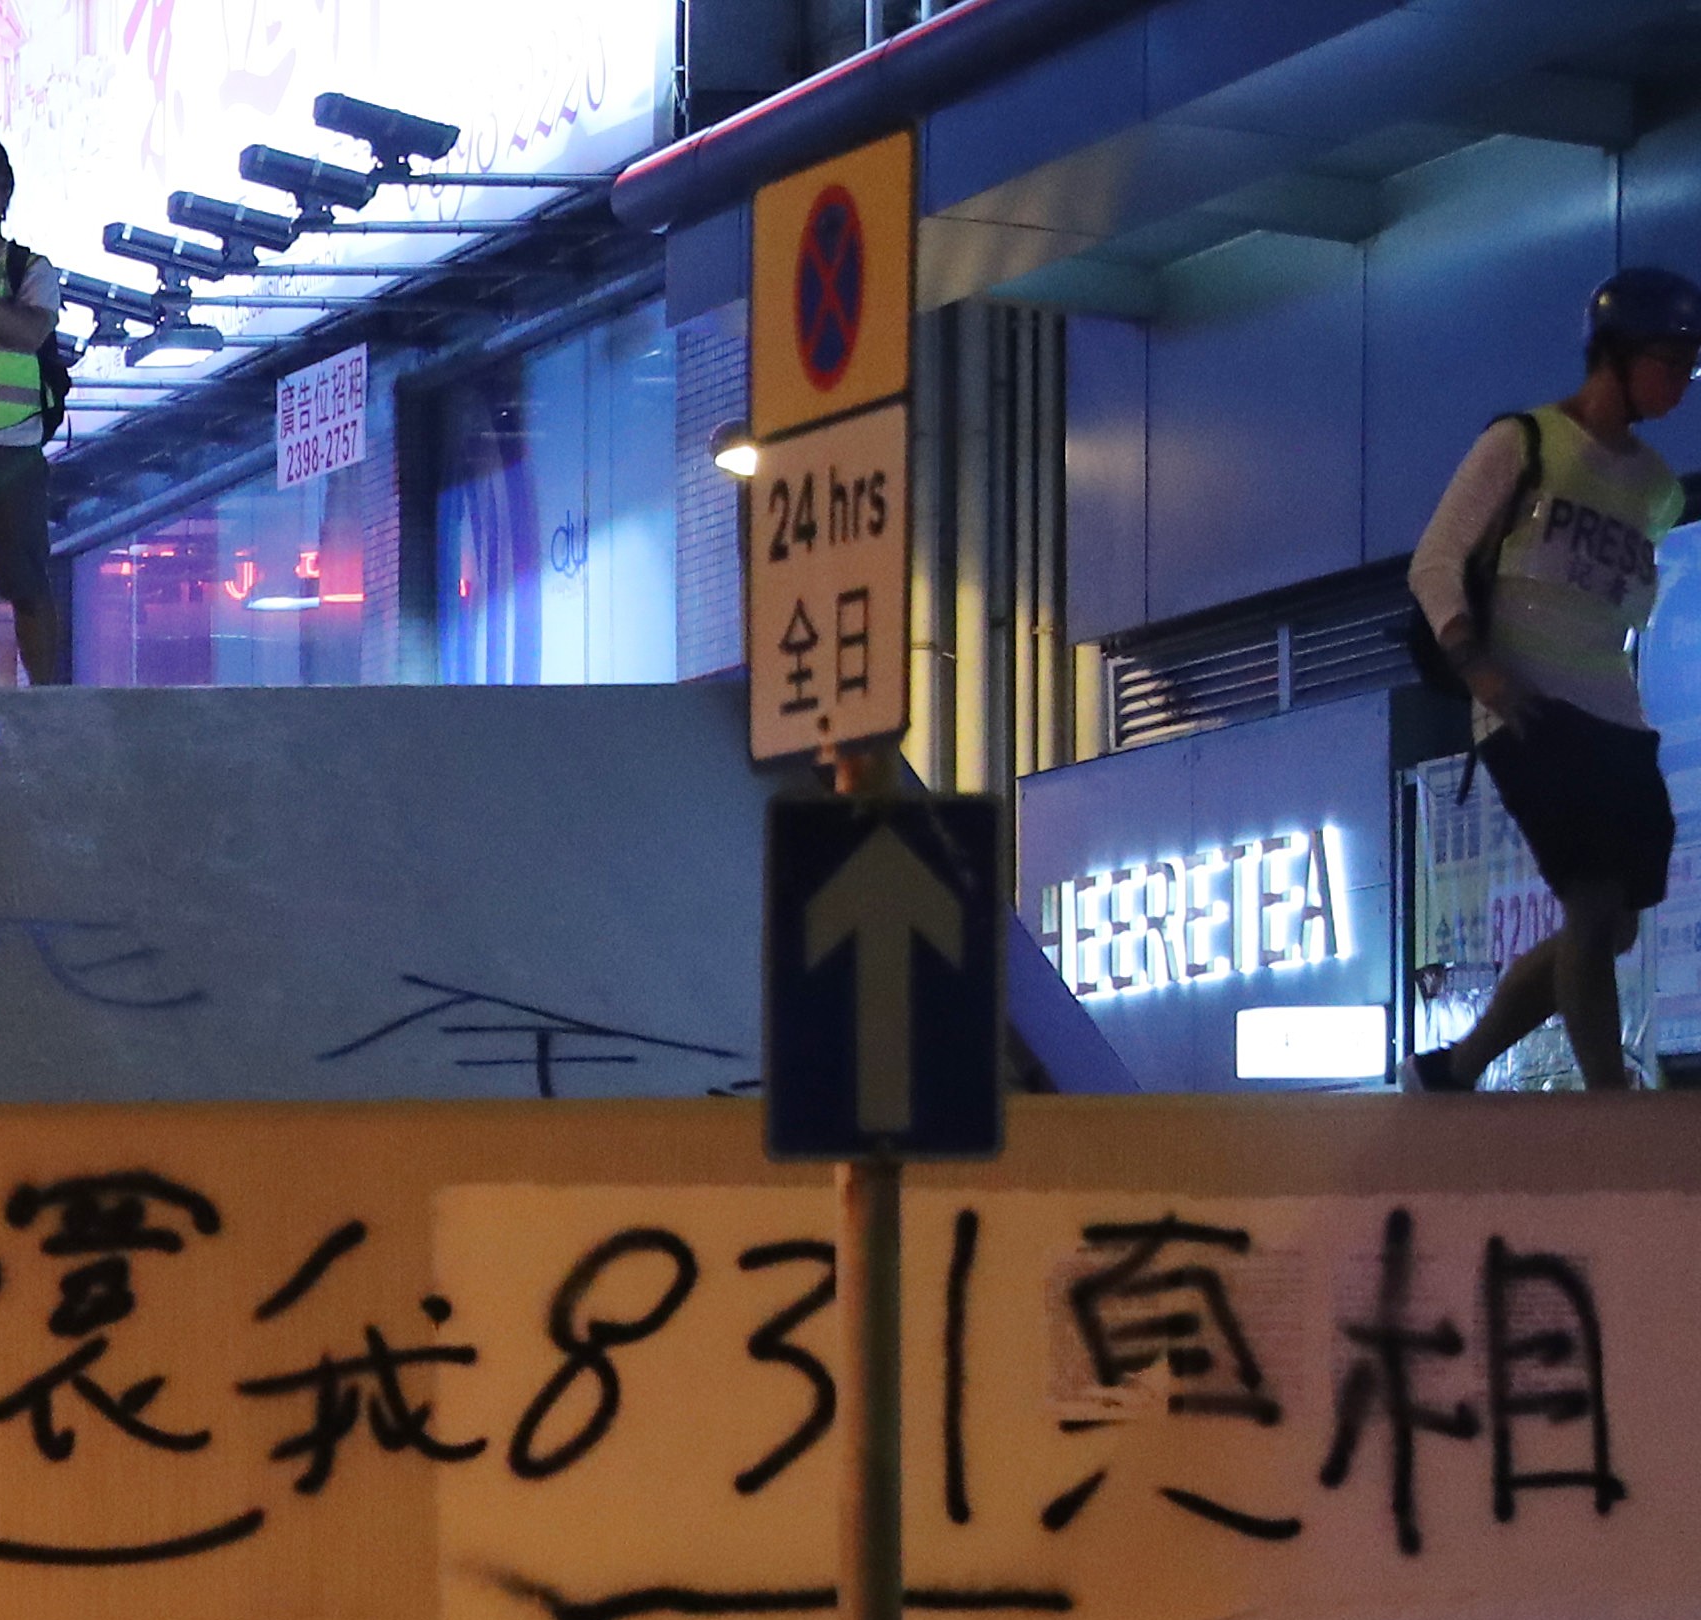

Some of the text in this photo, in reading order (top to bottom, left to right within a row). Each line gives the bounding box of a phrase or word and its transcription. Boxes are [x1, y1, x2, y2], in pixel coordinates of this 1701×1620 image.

[281, 356, 363, 440] 廣告位招租
[286, 419, 358, 483] 2398-2757
[769, 464, 886, 563] 24 hrs
[778, 585, 869, 716] 全日
